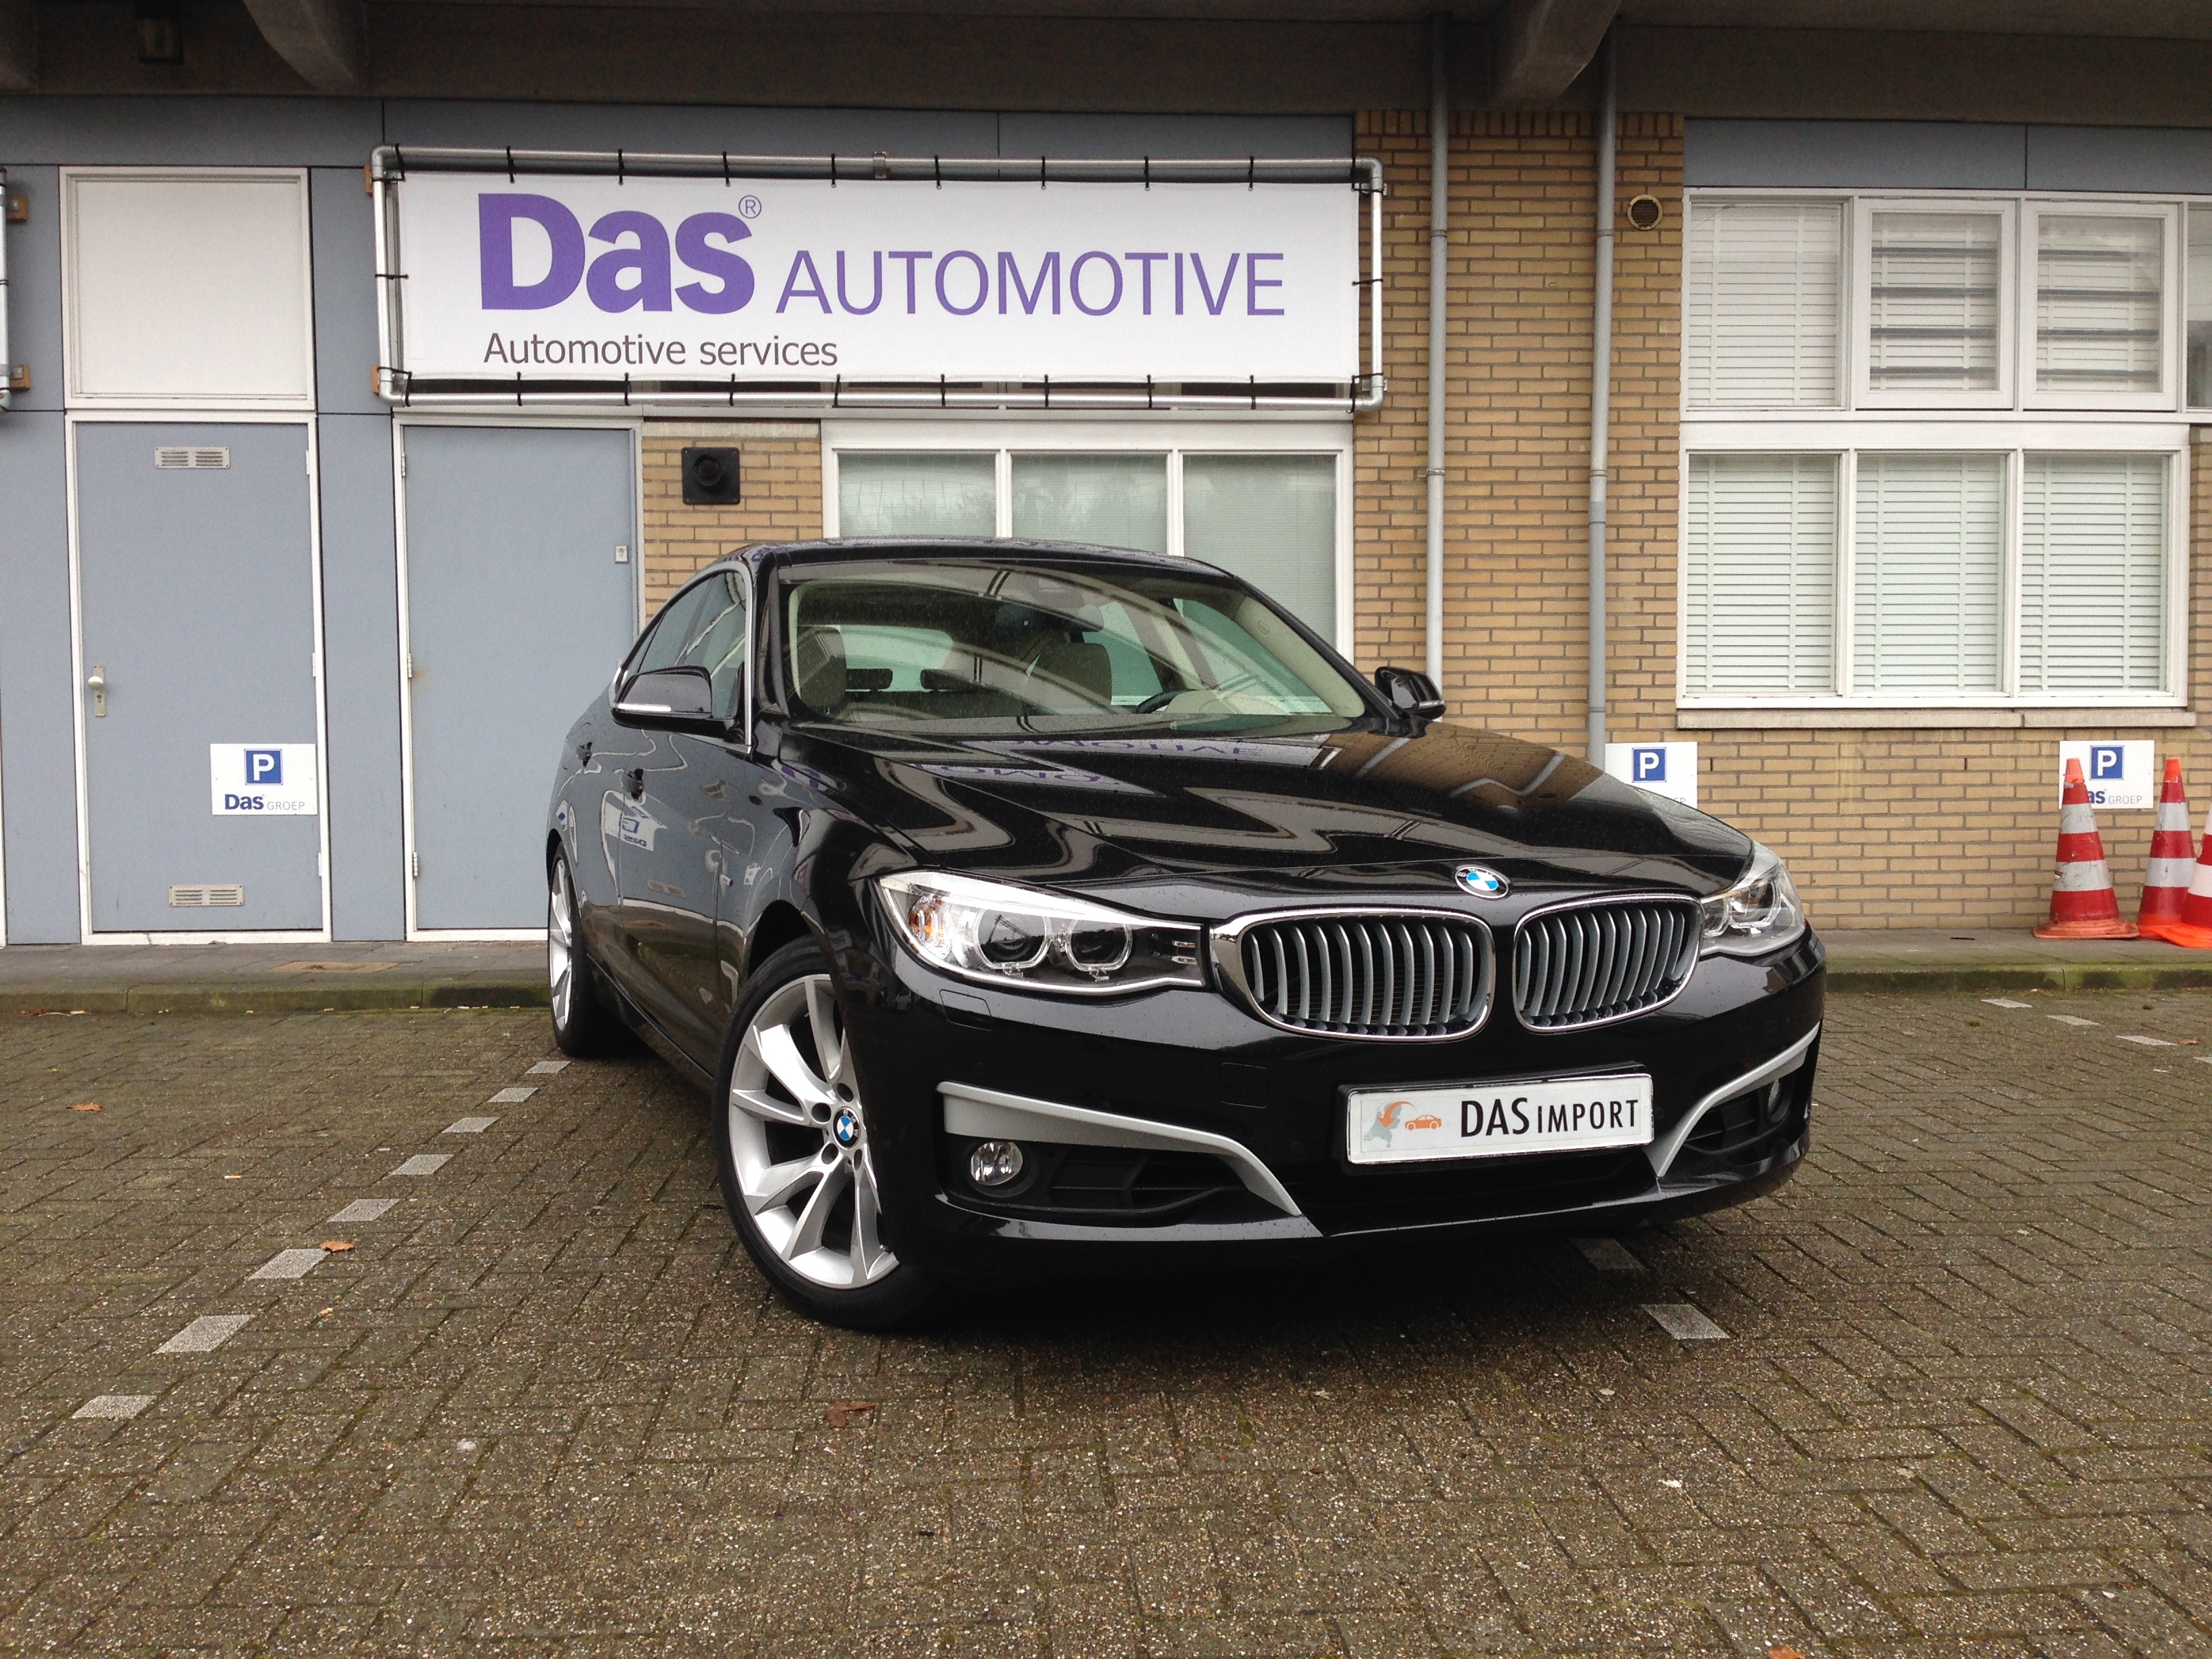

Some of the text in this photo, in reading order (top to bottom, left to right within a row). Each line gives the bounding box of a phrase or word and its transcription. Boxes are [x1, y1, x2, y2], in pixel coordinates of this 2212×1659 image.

[775, 249, 1286, 316] AUTOMOTIVE
[483, 332, 838, 367] Automotive services
[253, 754, 274, 781] P
[1640, 752, 1660, 779] P
[2097, 750, 2117, 776] P
[267, 801, 305, 811] GROEP
[2088, 790, 2142, 804] as GROEP
[1460, 1097, 1639, 1138] DAS IMPORT
